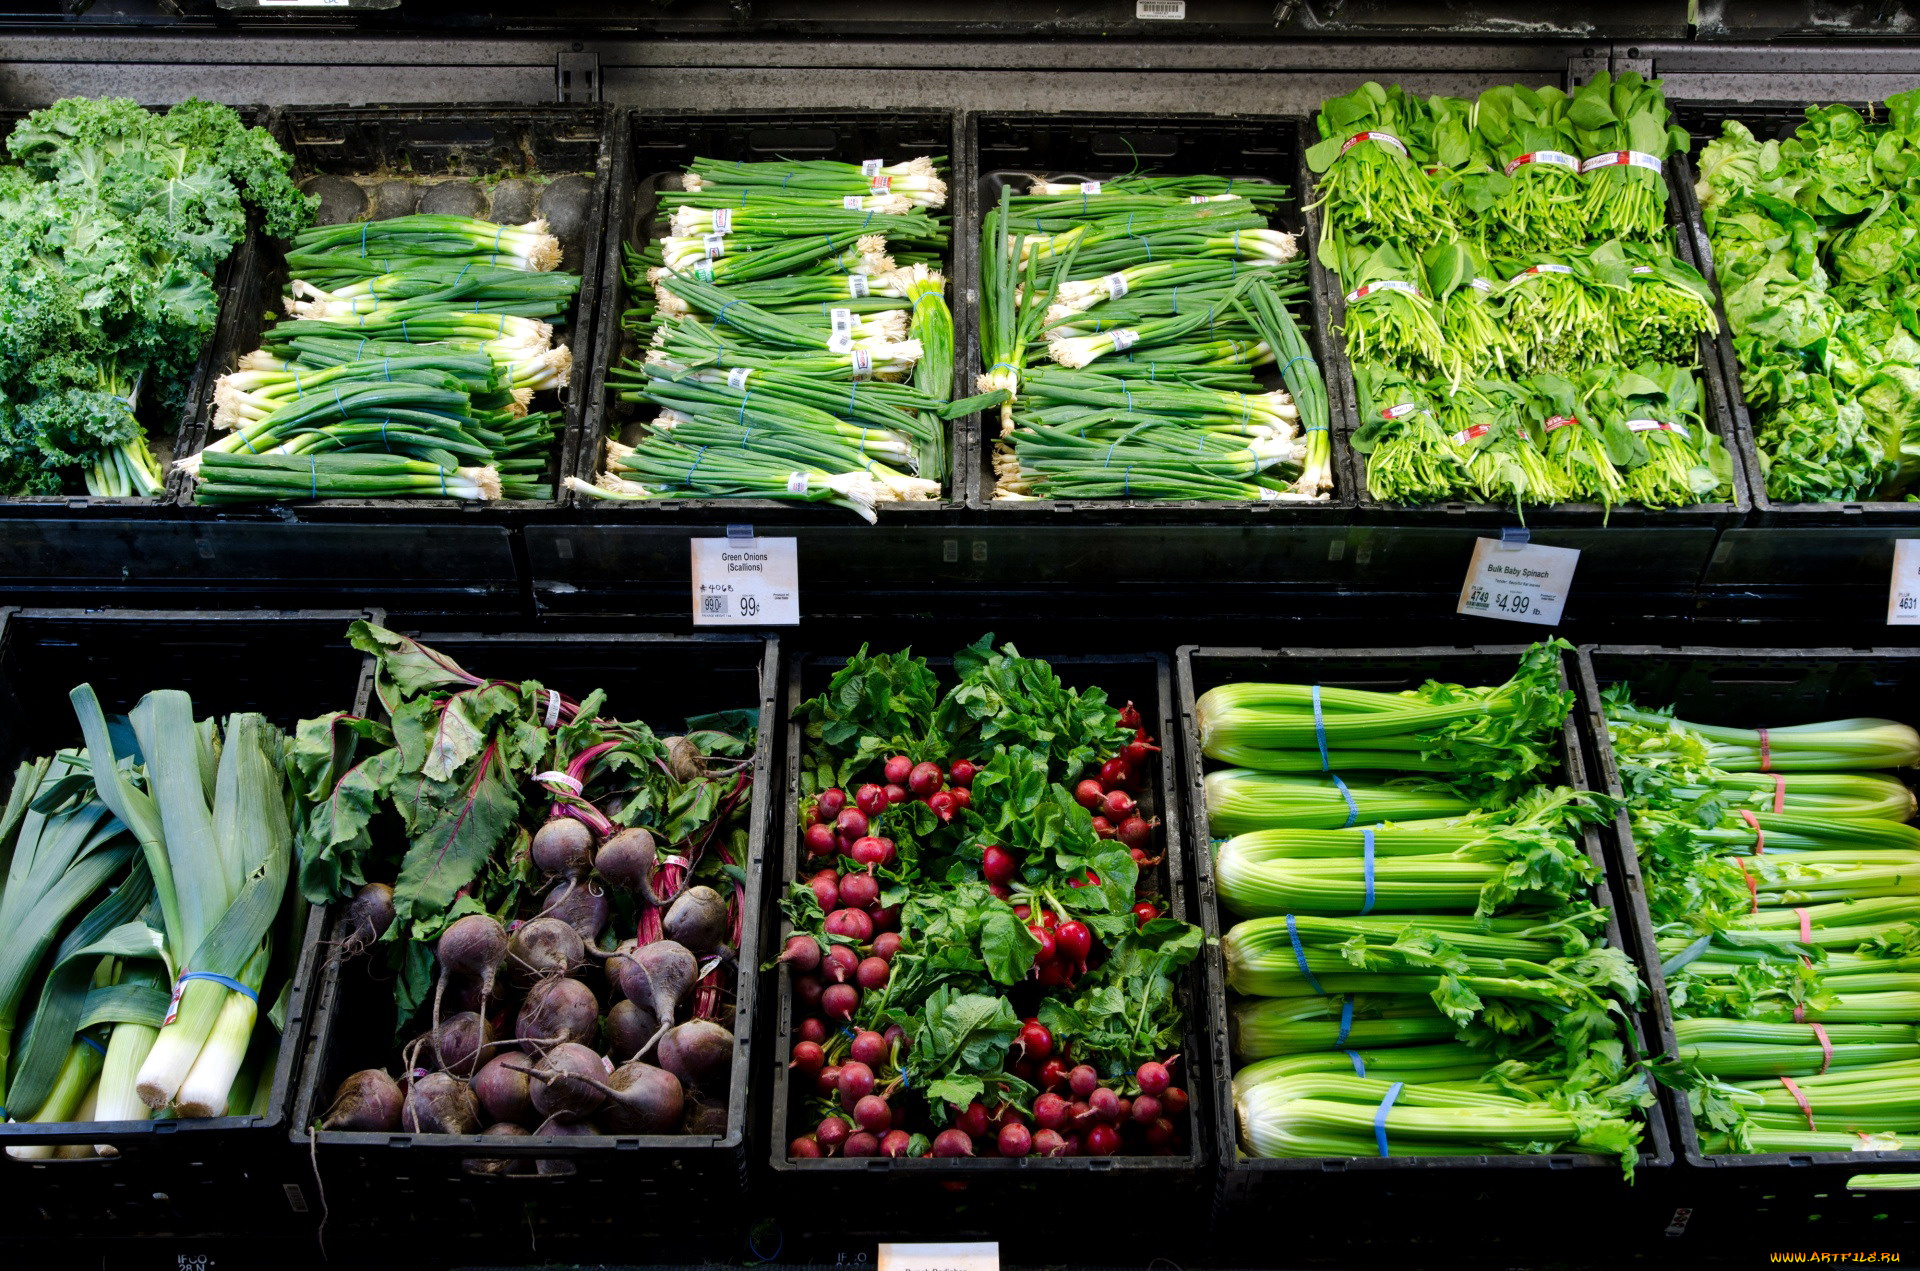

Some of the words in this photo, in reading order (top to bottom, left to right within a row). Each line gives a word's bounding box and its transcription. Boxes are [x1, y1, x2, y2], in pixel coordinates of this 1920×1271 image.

[722, 552, 742, 561] Green
[743, 552, 768, 561] Onions
[727, 563, 763, 573] (Scallions)
[1488, 564, 1503, 573] Bulk
[1504, 566, 1521, 577] Baby
[1522, 568, 1549, 578] Spinach
[1471, 591, 1489, 603] 4749
[1899, 597, 1917, 609] 4631
[740, 597, 760, 616] 99¢
[1495, 593, 1530, 614] $4.99
[178, 1254, 207, 1264] IFCO
[838, 1252, 867, 1262] IFO
